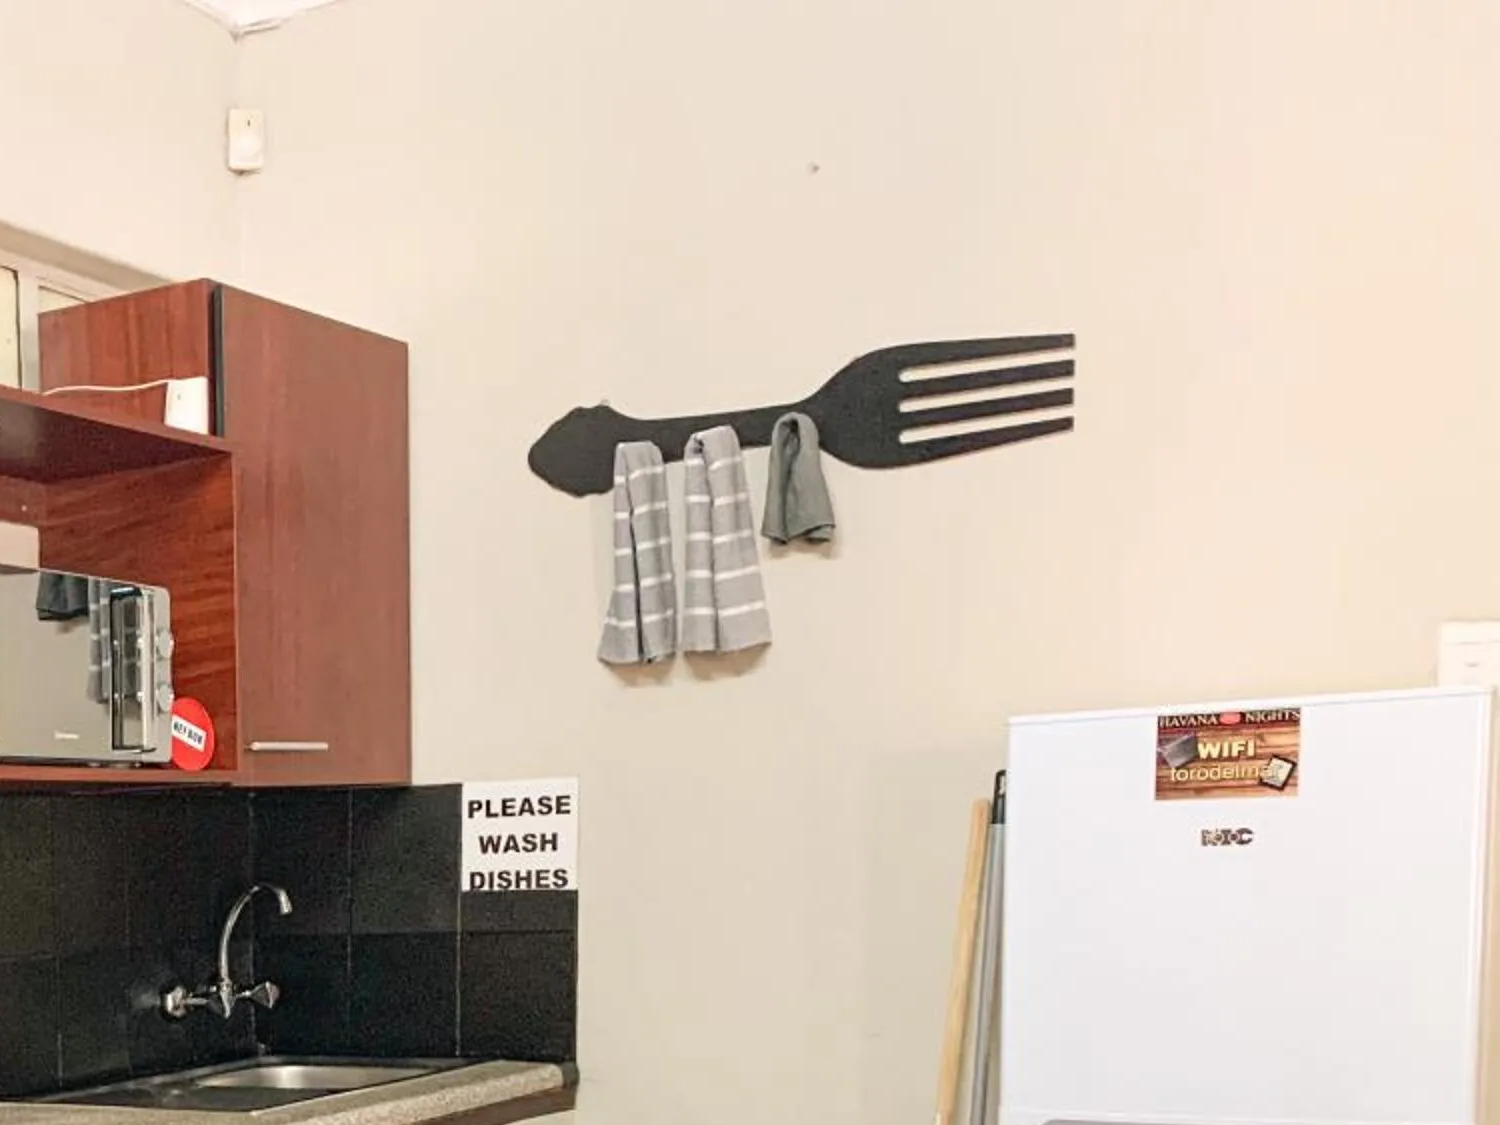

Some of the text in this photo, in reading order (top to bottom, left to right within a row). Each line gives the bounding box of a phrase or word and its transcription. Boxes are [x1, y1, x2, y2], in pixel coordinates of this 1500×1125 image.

[1159, 709, 1300, 728] HAVANA NIGHTS
[1197, 739, 1256, 760] WIFI
[467, 795, 571, 819] PLEASE
[478, 832, 558, 854] WASH
[469, 868, 569, 890] DISHES
